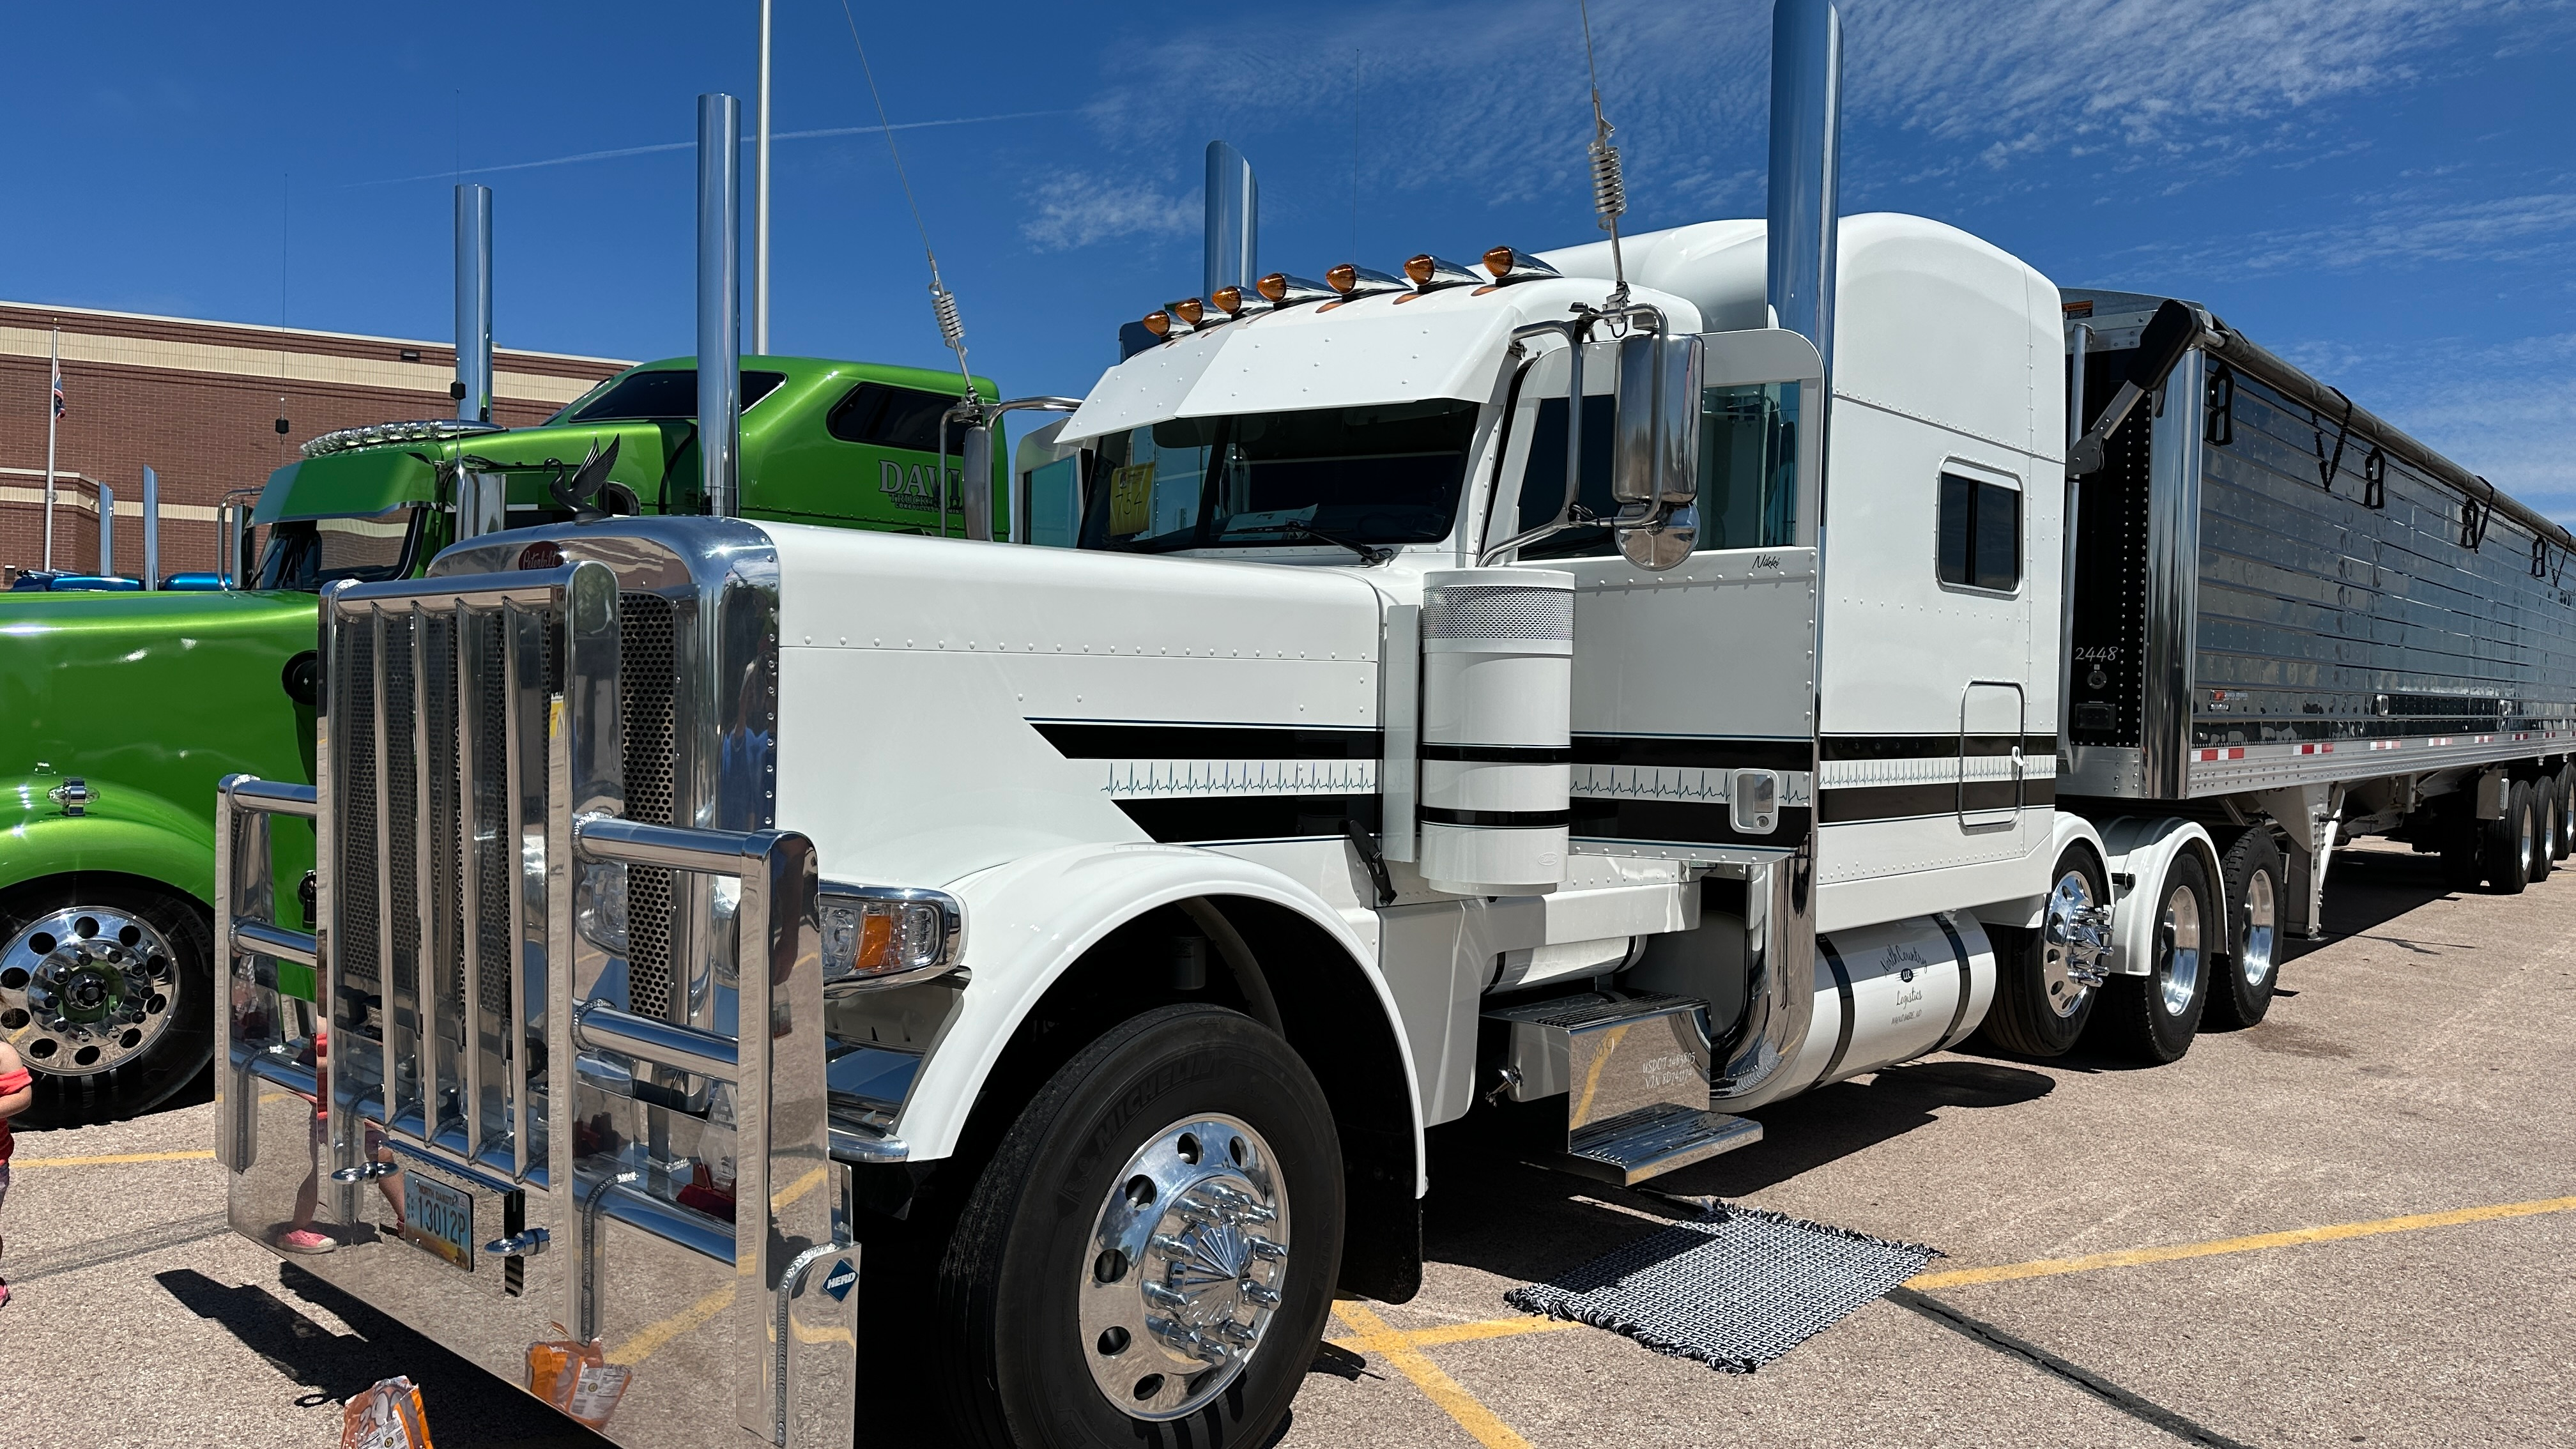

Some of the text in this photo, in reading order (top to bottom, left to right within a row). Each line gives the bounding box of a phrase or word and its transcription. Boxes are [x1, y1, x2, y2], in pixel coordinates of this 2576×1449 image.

[879, 460, 960, 500] DAVI
[1116, 491, 1142, 521] 754
[523, 550, 556, 570] Peterbilt
[1752, 554, 1781, 569] Nikki
[2075, 646, 2119, 662] 2448
[1896, 986, 1922, 1009] Logistics
[1643, 1052, 1696, 1073] USDOT 1483805
[1646, 1074, 1660, 1089] VIN
[1094, 1052, 1215, 1153] MICHELIN
[418, 1184, 434, 1199] NORTH
[418, 1196, 466, 1246] 13012P
[827, 1272, 855, 1289] HERD
